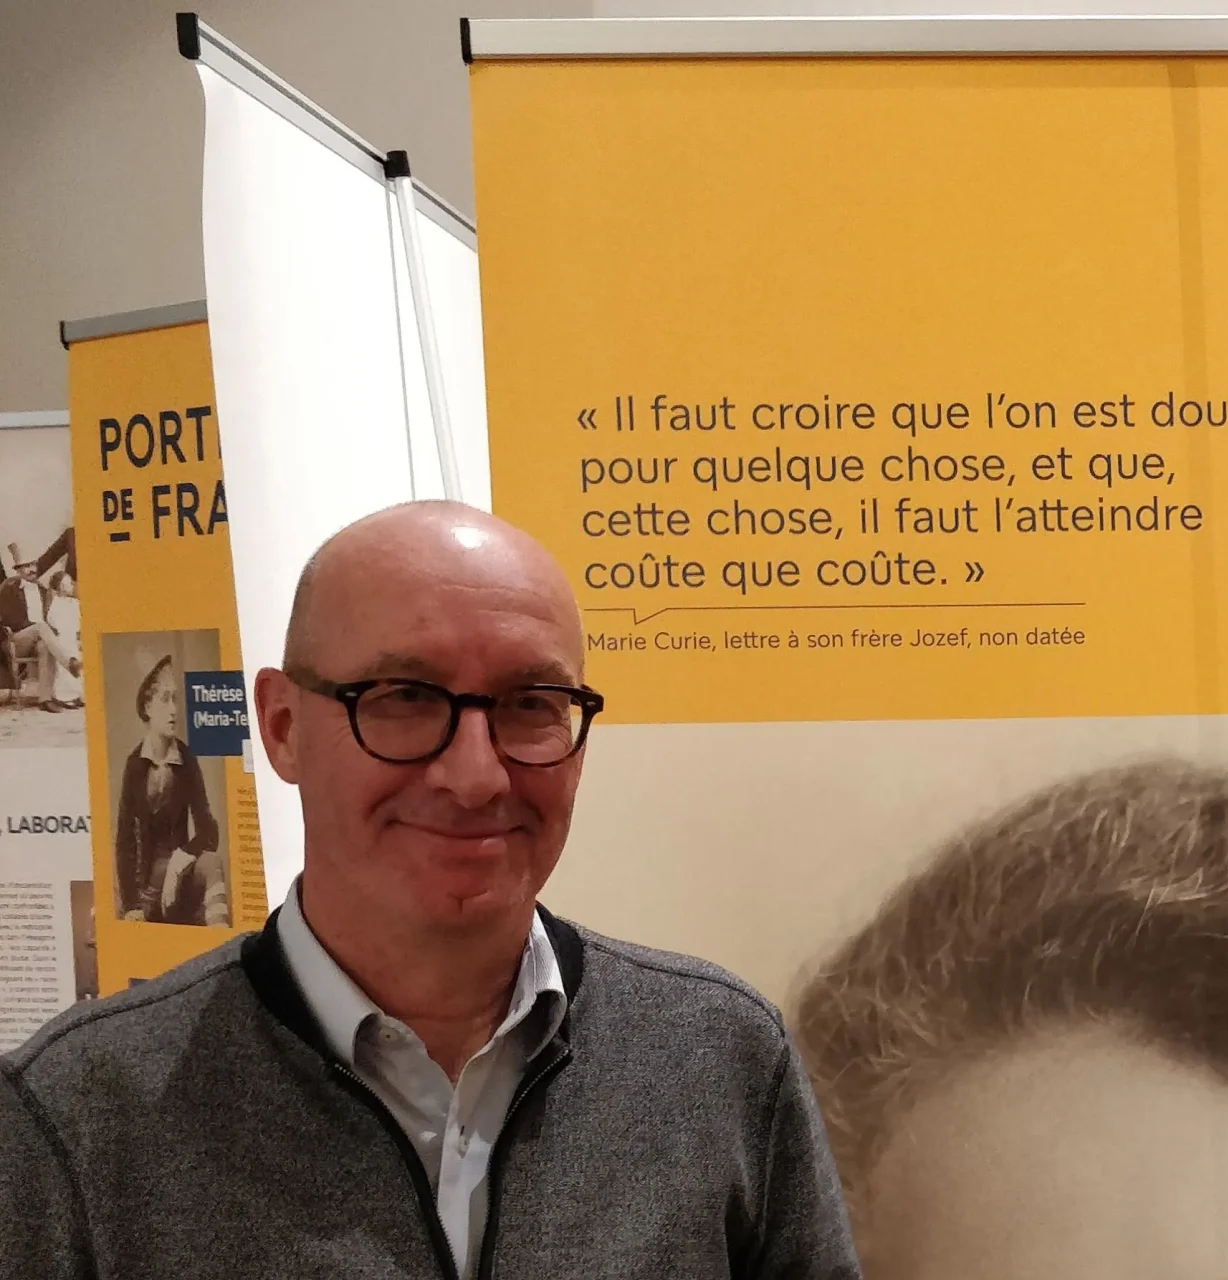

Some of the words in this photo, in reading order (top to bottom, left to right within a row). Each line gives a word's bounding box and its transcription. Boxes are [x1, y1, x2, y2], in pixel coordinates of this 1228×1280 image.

[616, 395, 634, 431] Il
[651, 394, 735, 431] faut
[753, 394, 875, 430] croire
[892, 402, 969, 437] que
[987, 393, 1055, 429] l’on
[1074, 394, 1135, 428] est
[100, 406, 221, 471] PORT
[582, 457, 677, 493] pour
[693, 446, 864, 492] quelque
[881, 446, 1015, 487] chose,
[1032, 446, 1072, 481] et
[1089, 453, 1174, 488] que,
[103, 488, 133, 522] DE
[583, 502, 690, 537] cette
[708, 499, 842, 541] chose,
[861, 497, 878, 533] il
[895, 497, 978, 534] faut
[996, 496, 1202, 533] l’atteindre
[585, 553, 705, 590] coûte
[722, 560, 799, 596] que
[817, 550, 946, 587] coûte.
[588, 632, 646, 652] Marie
[655, 631, 716, 652] Curie,
[725, 631, 780, 650] lettre
[788, 630, 799, 649] à
[807, 633, 843, 649] son
[851, 628, 902, 648] frère
[910, 627, 971, 649] Jozef,
[980, 632, 1017, 646] non
[1026, 626, 1085, 646] datée
[192, 684, 244, 702] Thérèse
